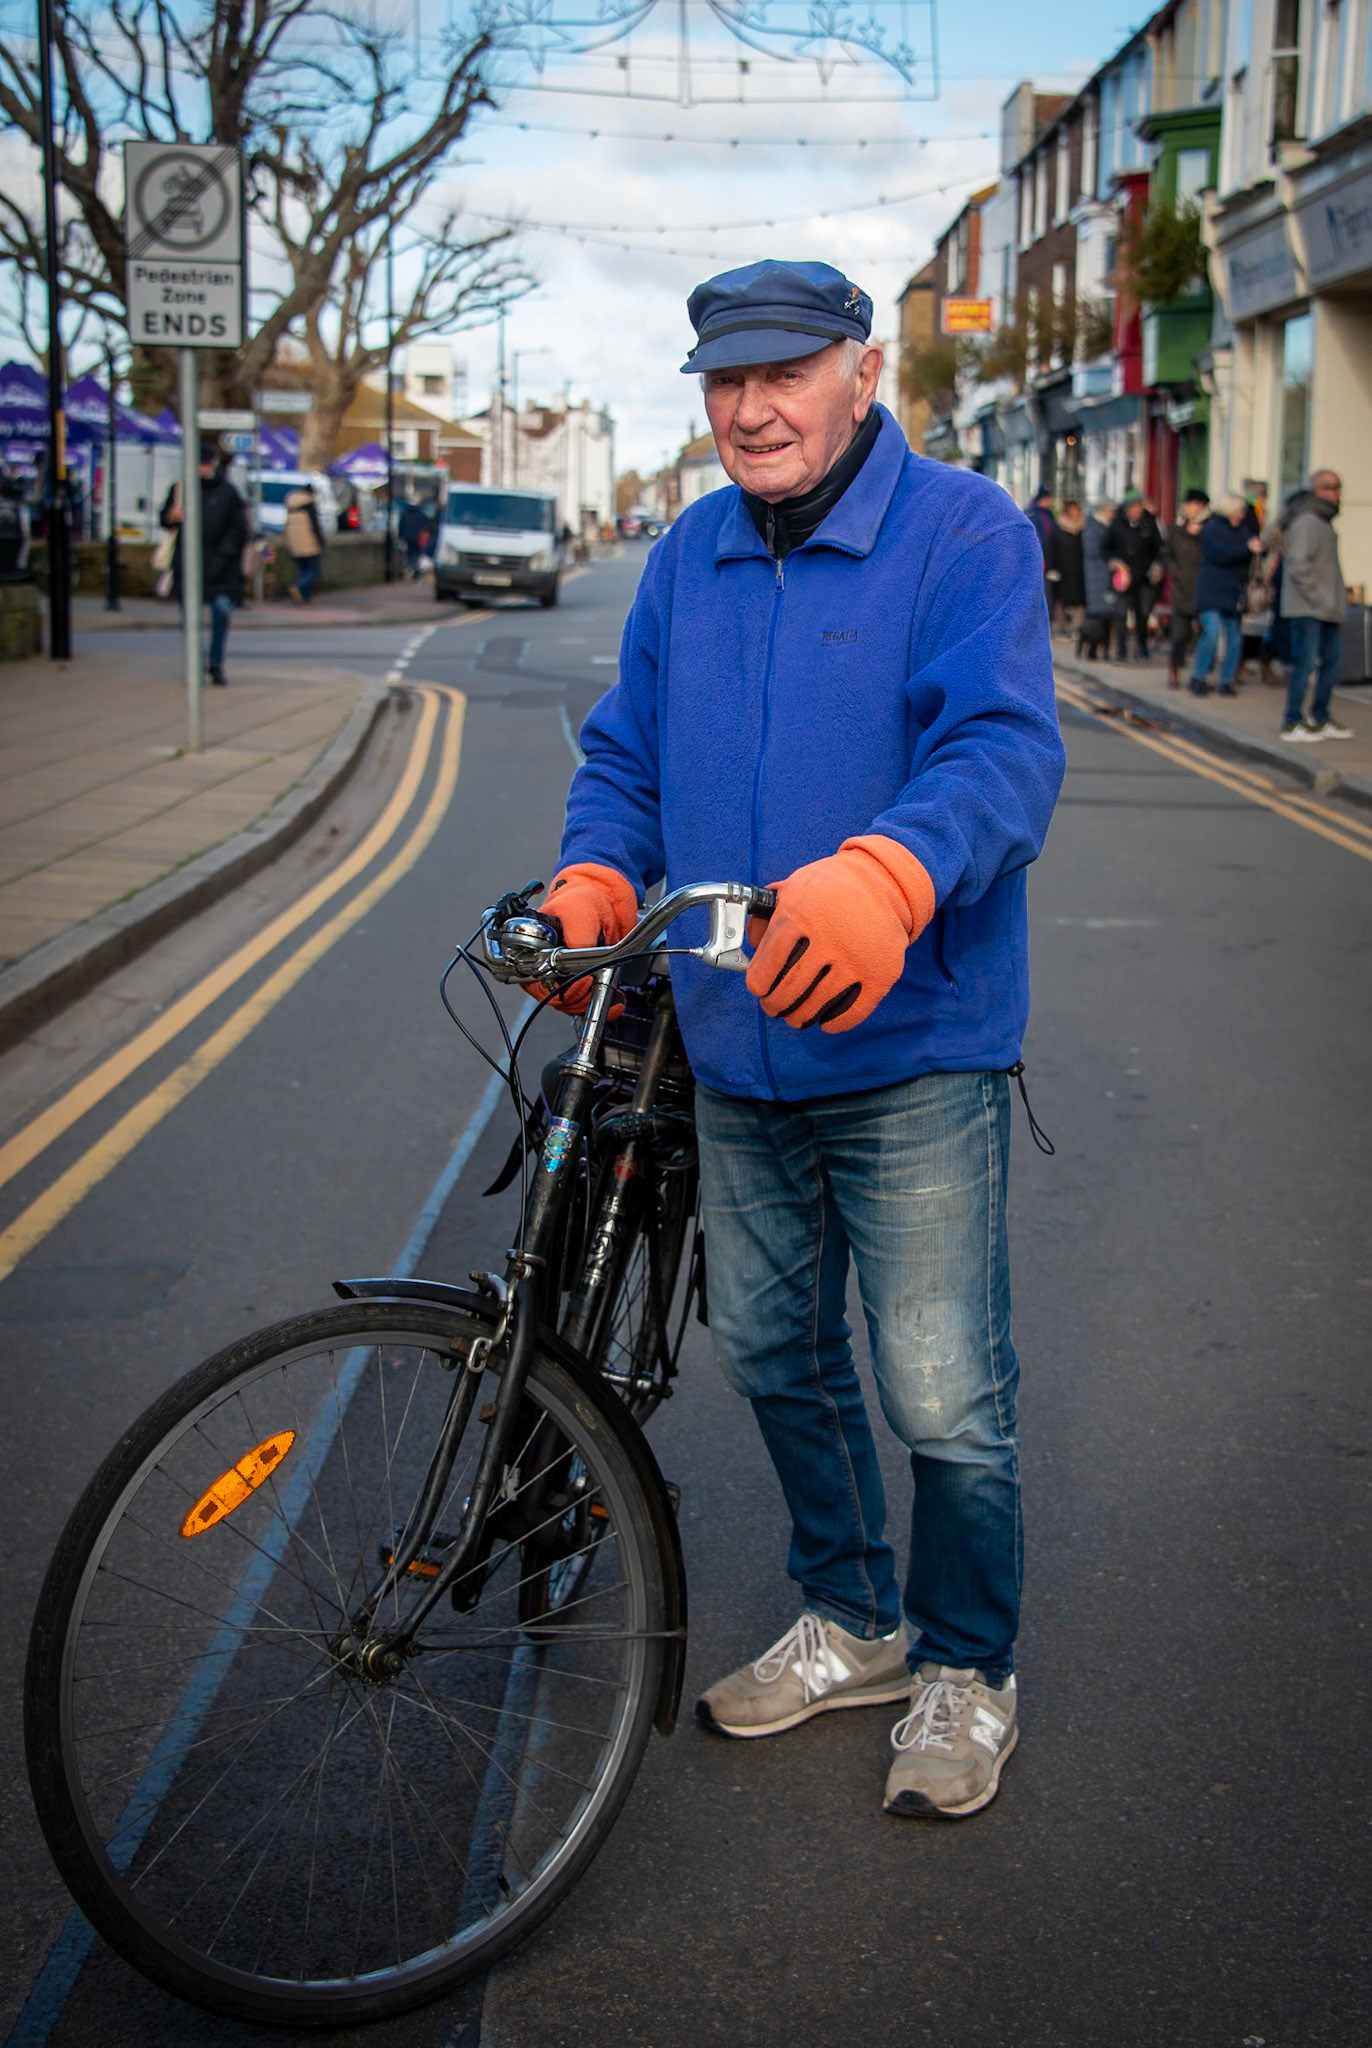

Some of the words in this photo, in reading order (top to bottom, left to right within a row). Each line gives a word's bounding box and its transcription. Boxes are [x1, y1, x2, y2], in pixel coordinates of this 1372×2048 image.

[135, 266, 234, 284] Pedestrian
[161, 287, 208, 305] Zone
[142, 312, 227, 337] ENDS
[822, 629, 858, 641] REGATTA
